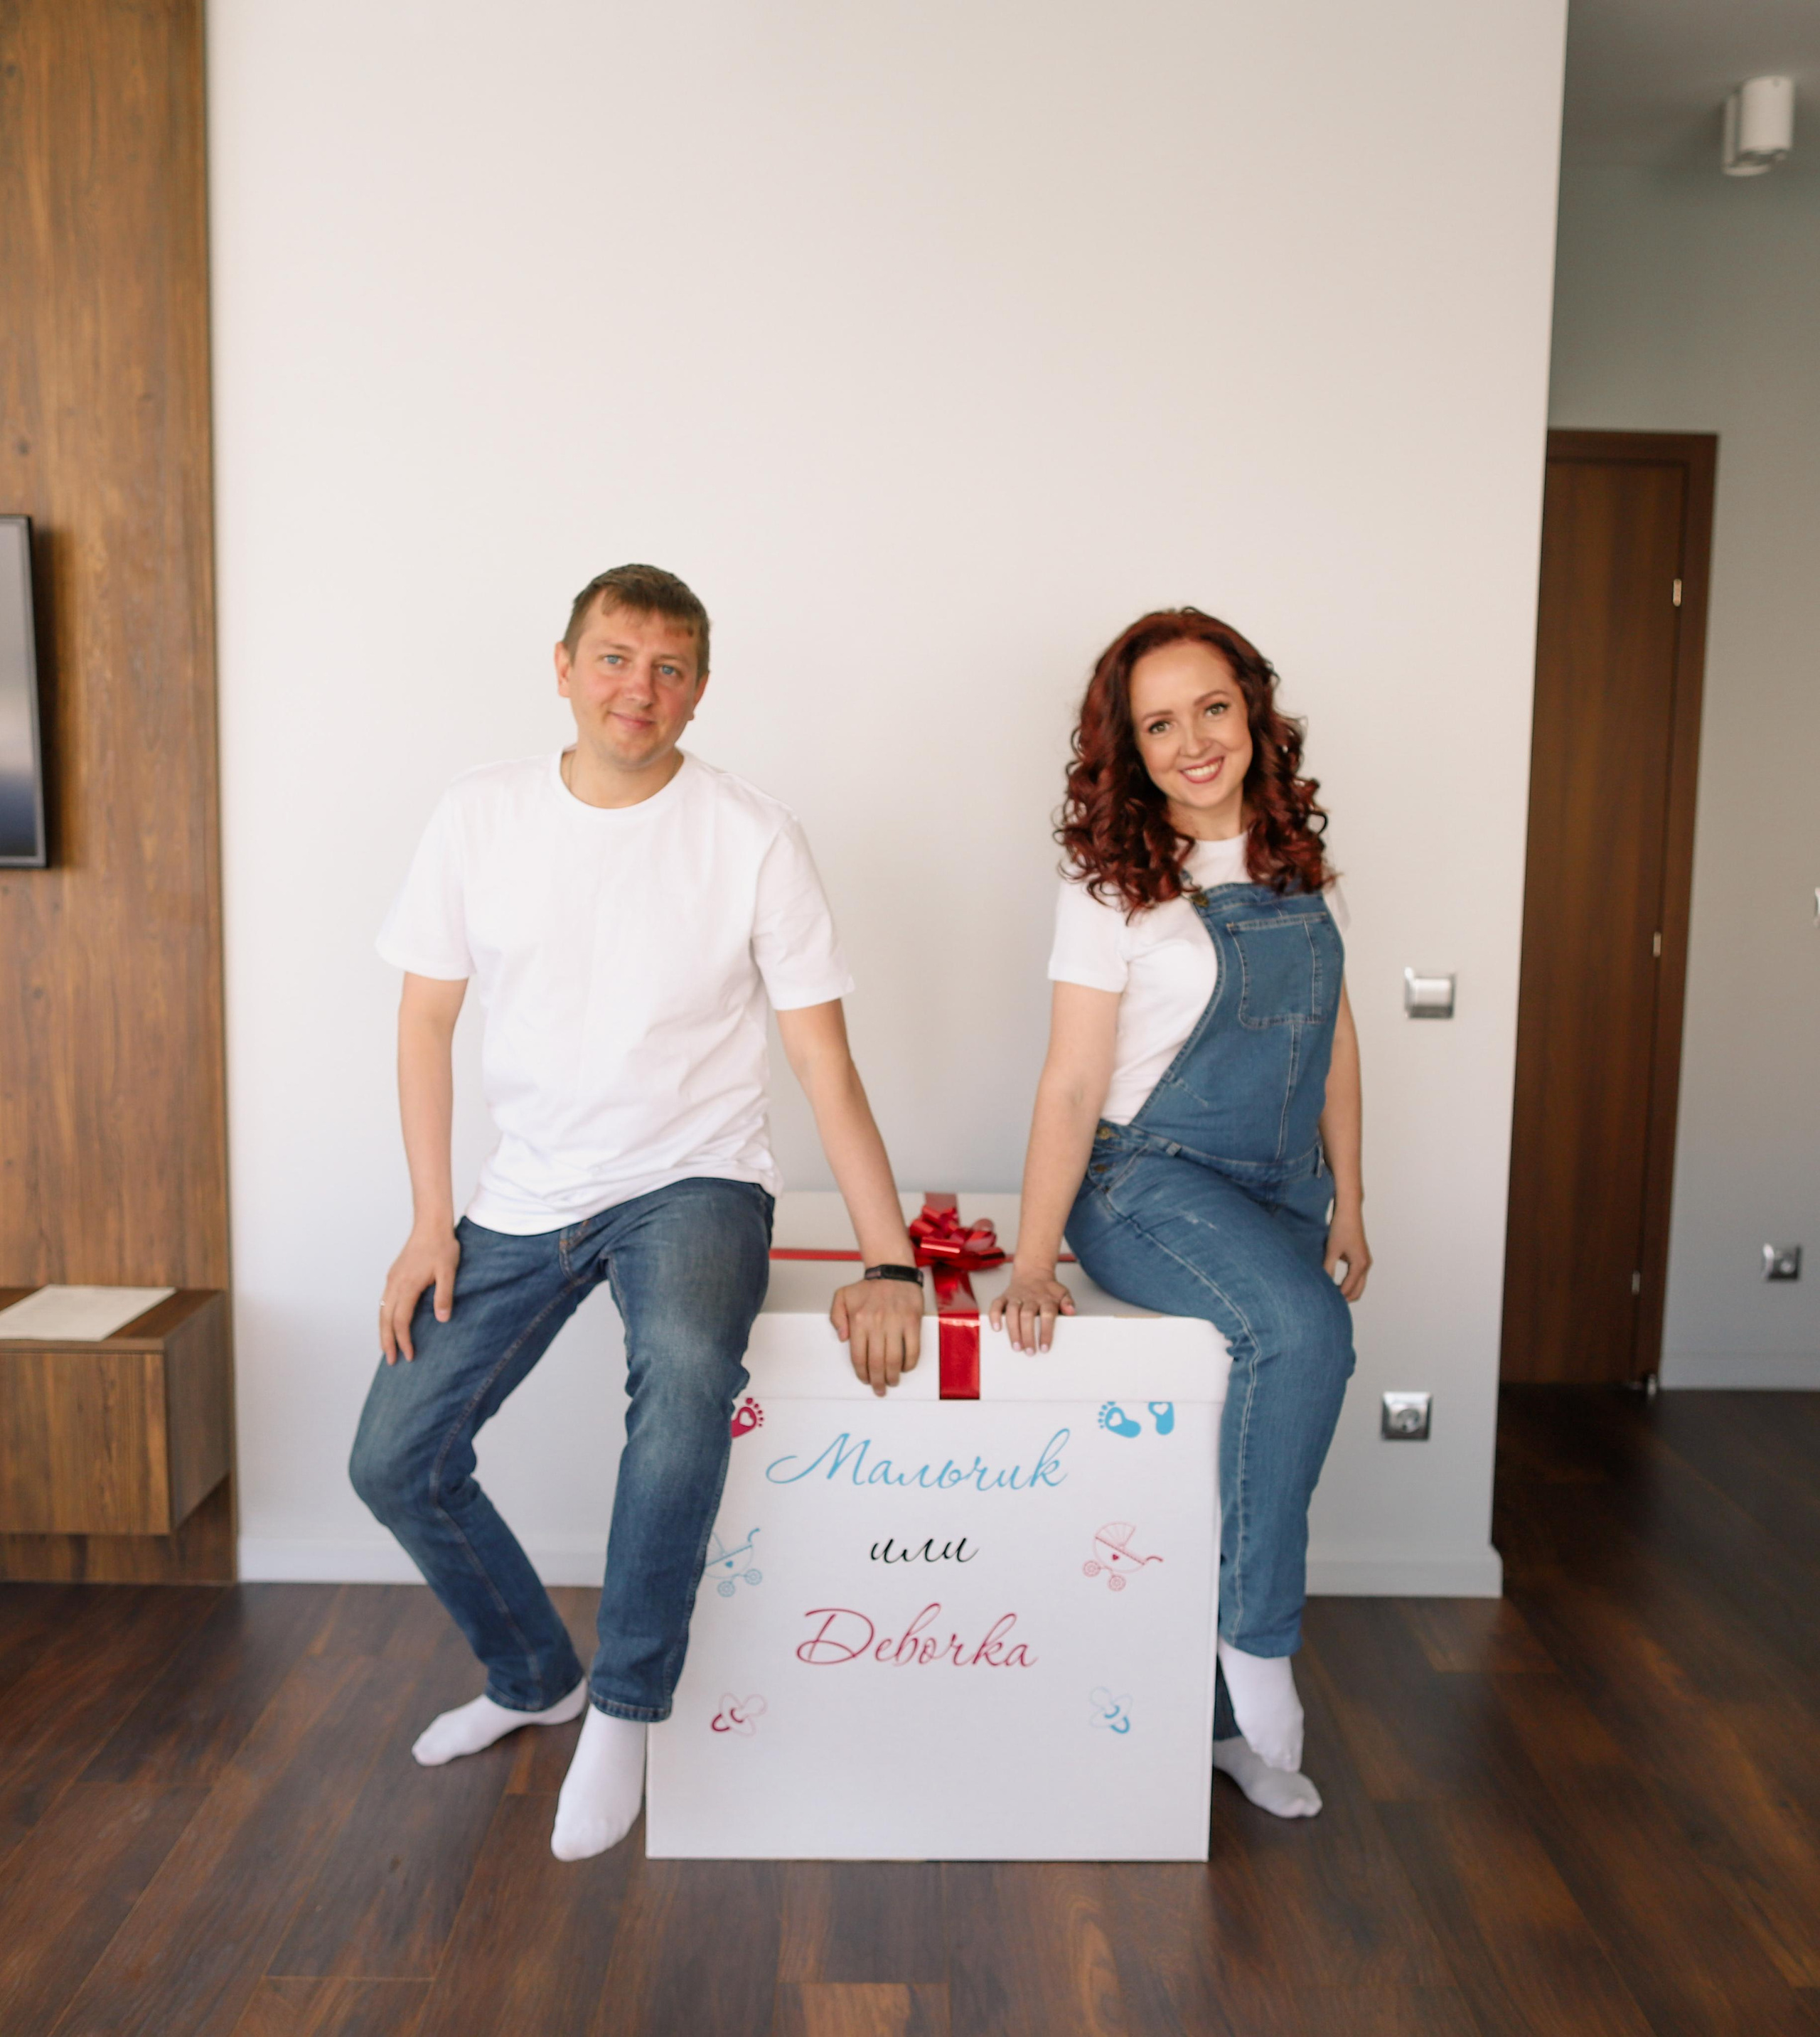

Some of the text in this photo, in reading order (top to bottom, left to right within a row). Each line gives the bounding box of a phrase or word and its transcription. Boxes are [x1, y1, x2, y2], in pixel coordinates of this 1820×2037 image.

[766, 1428, 1071, 1492] Мальчик
[869, 1536, 979, 1563] или
[795, 1602, 1038, 1668] Девочка
